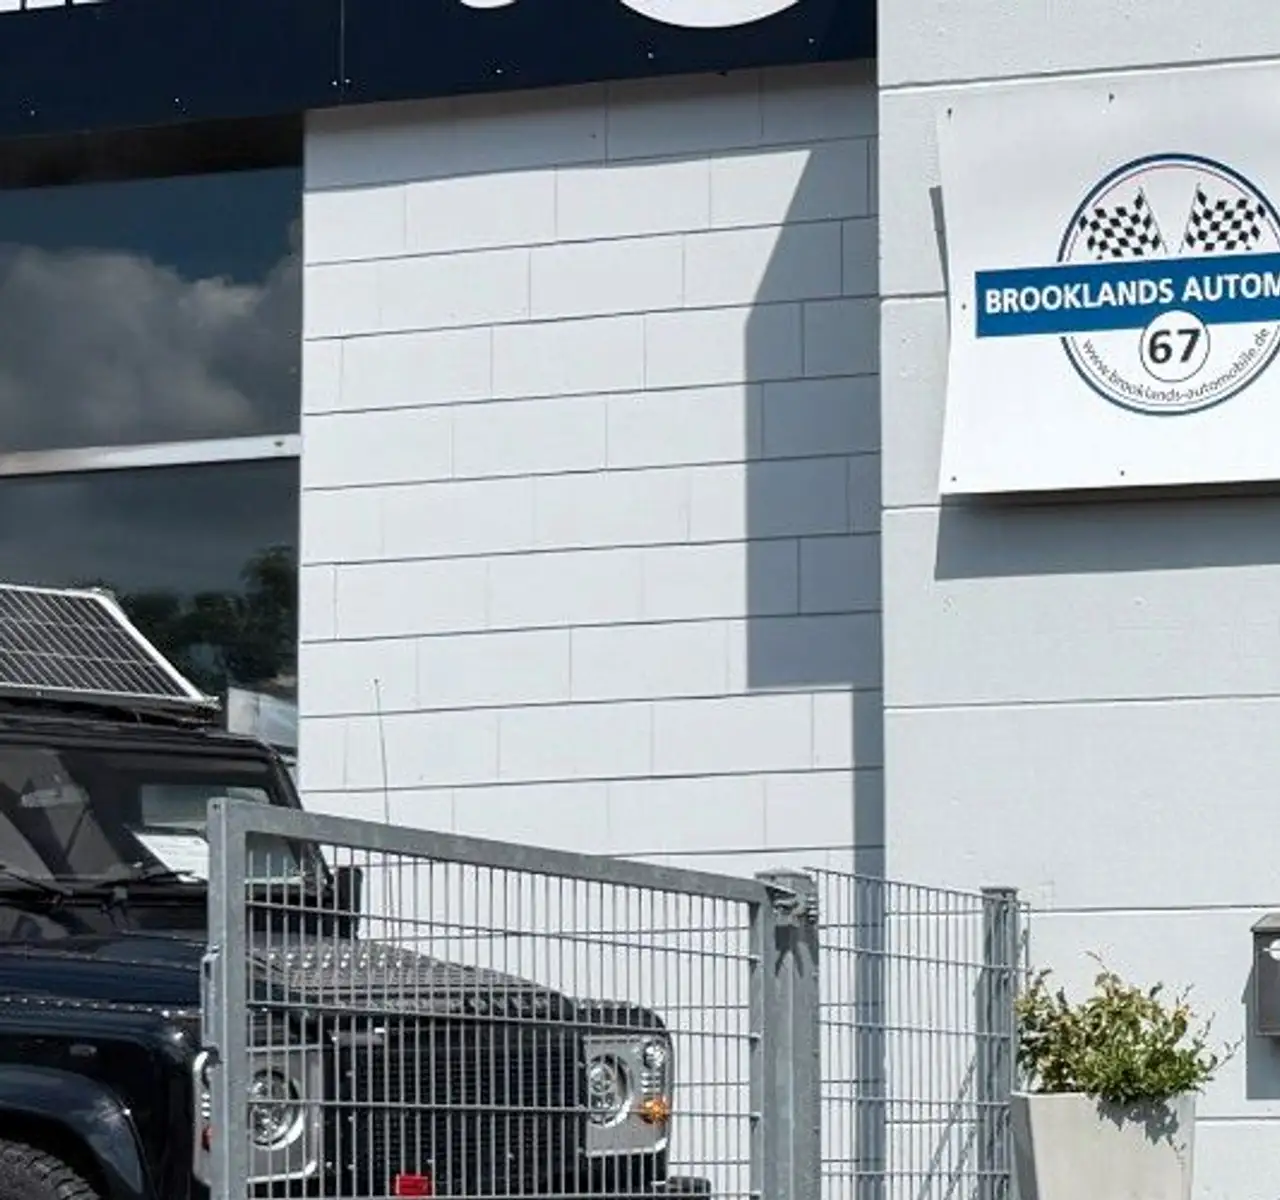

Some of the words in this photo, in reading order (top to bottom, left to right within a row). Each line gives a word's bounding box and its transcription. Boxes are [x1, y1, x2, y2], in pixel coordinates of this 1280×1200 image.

[985, 278, 1173, 314] BROOKLANDS
[1148, 328, 1201, 364] 67
[1082, 327, 1272, 402] www.brooklands-automobile.de
